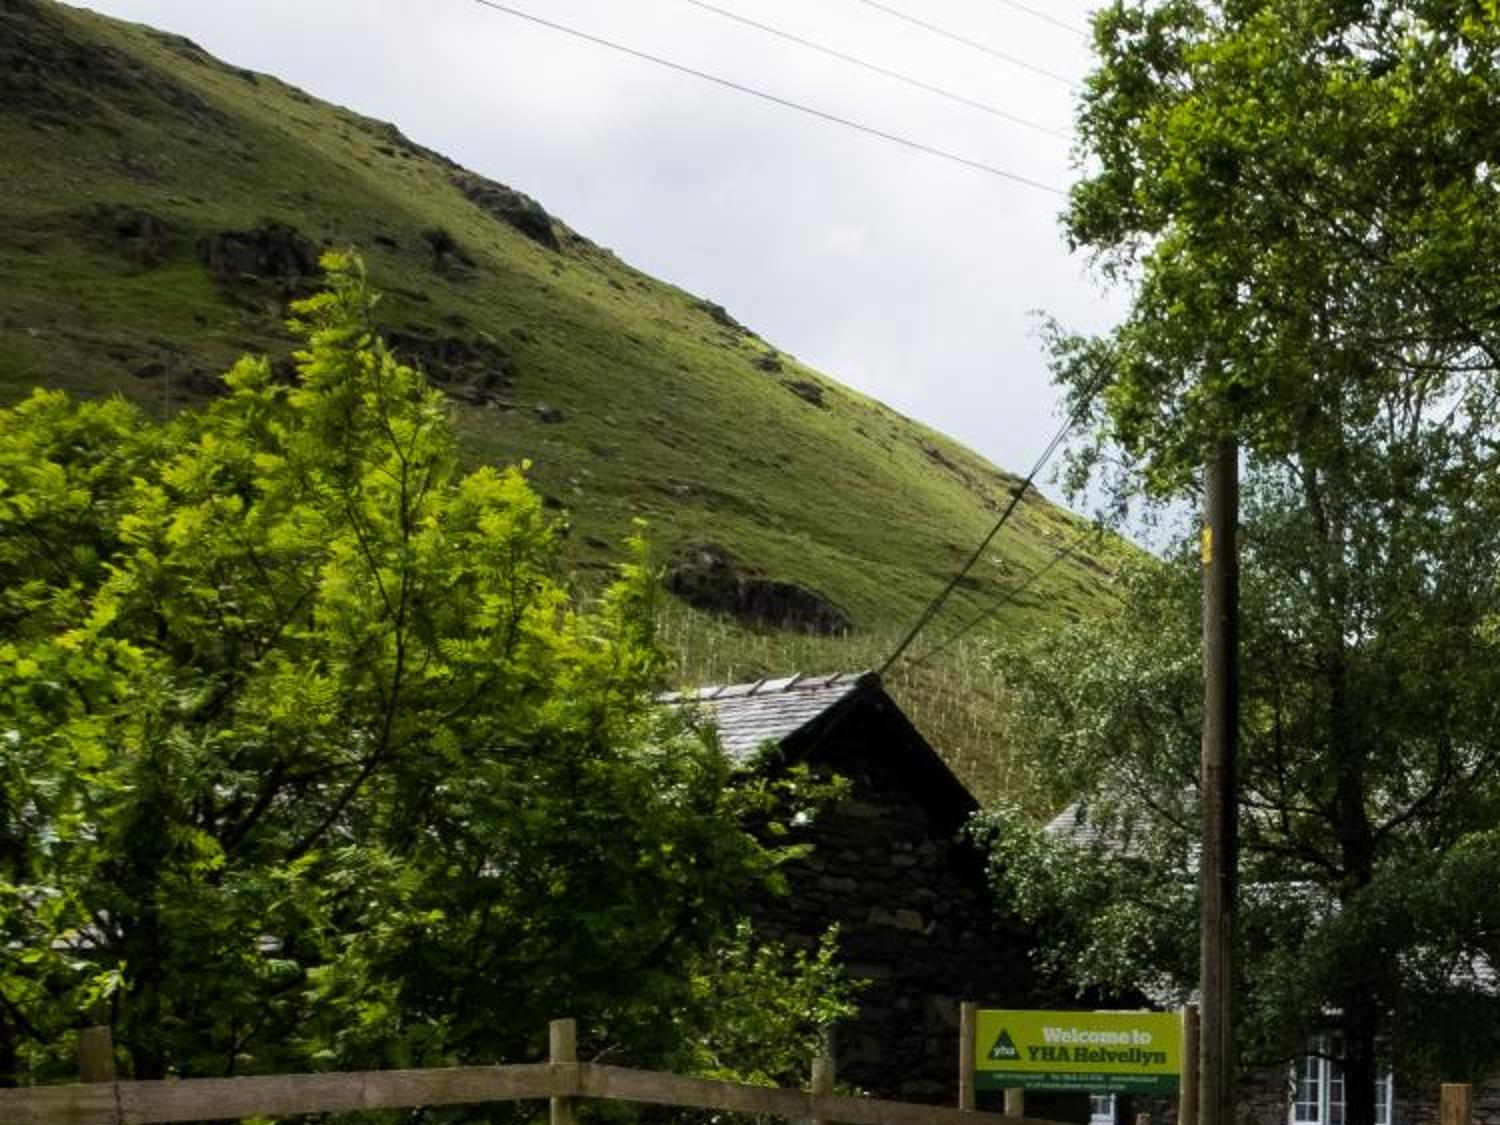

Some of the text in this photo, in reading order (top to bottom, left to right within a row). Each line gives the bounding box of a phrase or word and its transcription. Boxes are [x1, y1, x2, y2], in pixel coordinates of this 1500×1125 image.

[1042, 1027, 1152, 1045] Welcome to
[993, 1046, 1015, 1058] yha
[1027, 1046, 1167, 1066] YHA Helvellyn
